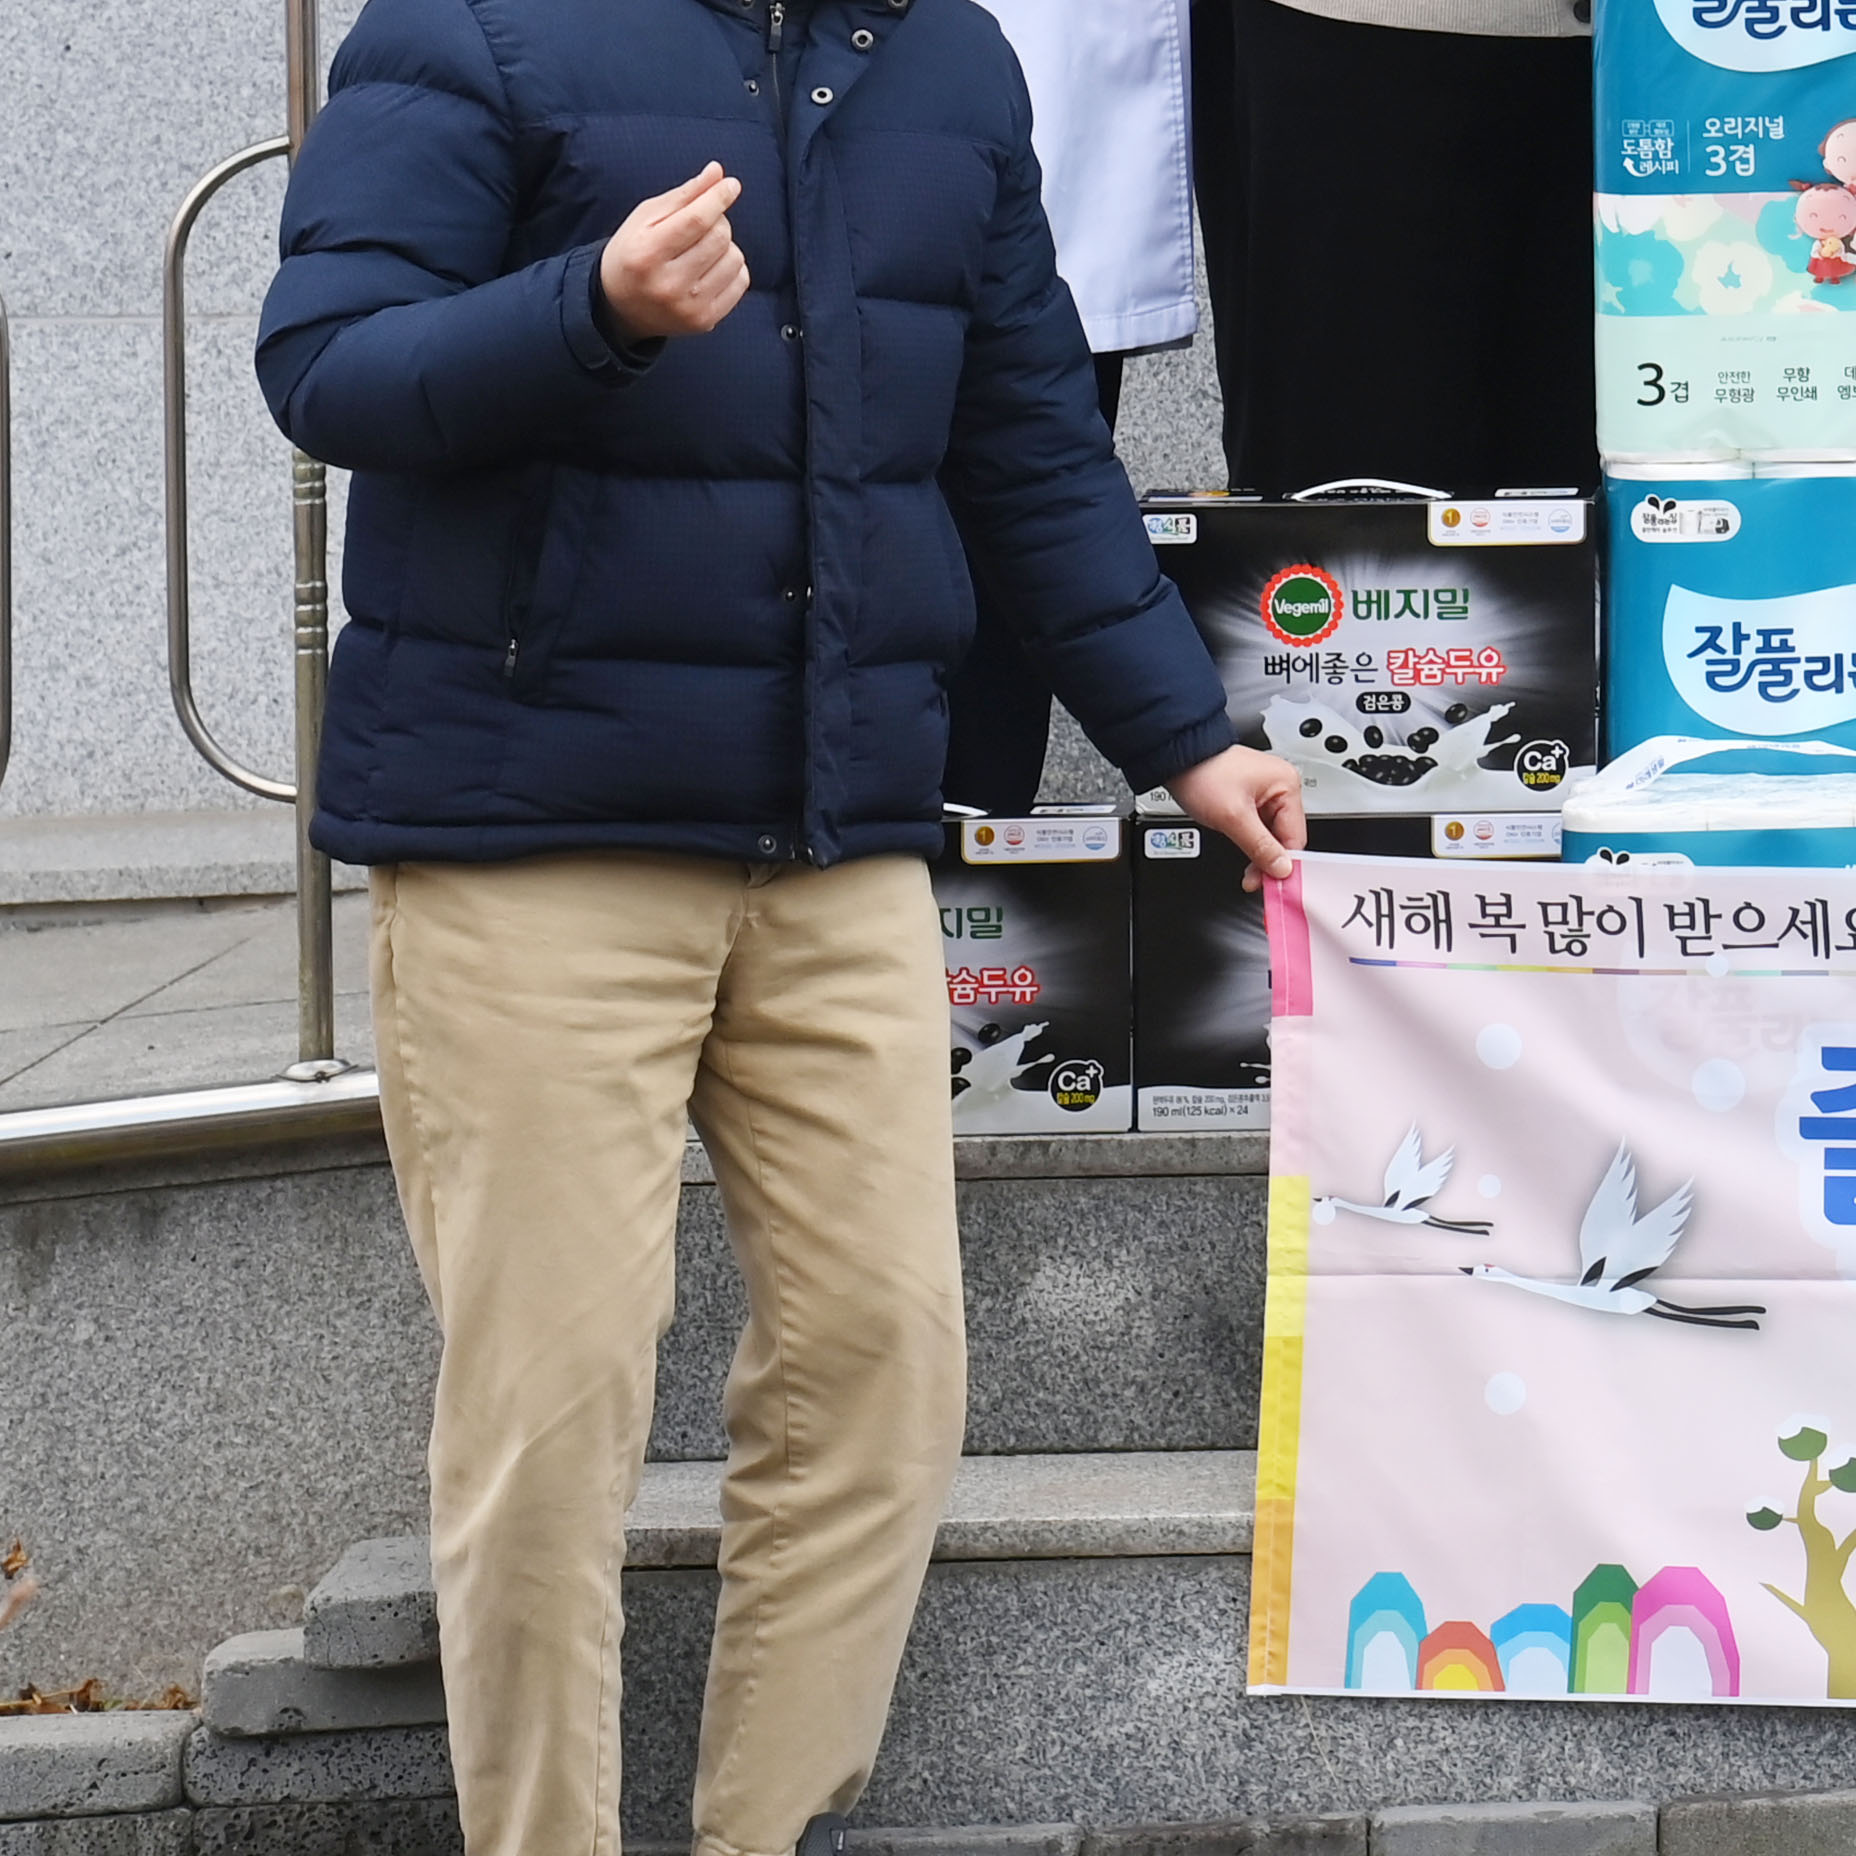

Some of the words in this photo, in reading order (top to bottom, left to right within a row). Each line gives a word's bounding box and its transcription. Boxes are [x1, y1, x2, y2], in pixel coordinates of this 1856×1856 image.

[1703, 115, 1785, 140] 오리지널
[1621, 138, 1674, 159] 도톰함
[1705, 143, 1755, 176] 3겹
[1718, 370, 1750, 384] 안전한
[1783, 366, 1810, 382] 무향
[1714, 386, 1755, 404] 무형광
[1776, 383, 1818, 402] 무인쇄
[1274, 598, 1330, 618] Vegemil
[1351, 588, 1470, 621] 베지밀
[1264, 652, 1379, 685] 뼈에좋은
[1387, 648, 1506, 686] 칼슘두유
[1362, 694, 1406, 712] 검은콩
[940, 907, 1003, 940] 지밀
[1341, 887, 1453, 953] 새해
[1467, 890, 1527, 955] 복
[1541, 890, 1642, 958] 많이
[950, 966, 1040, 1004] 슘두유
